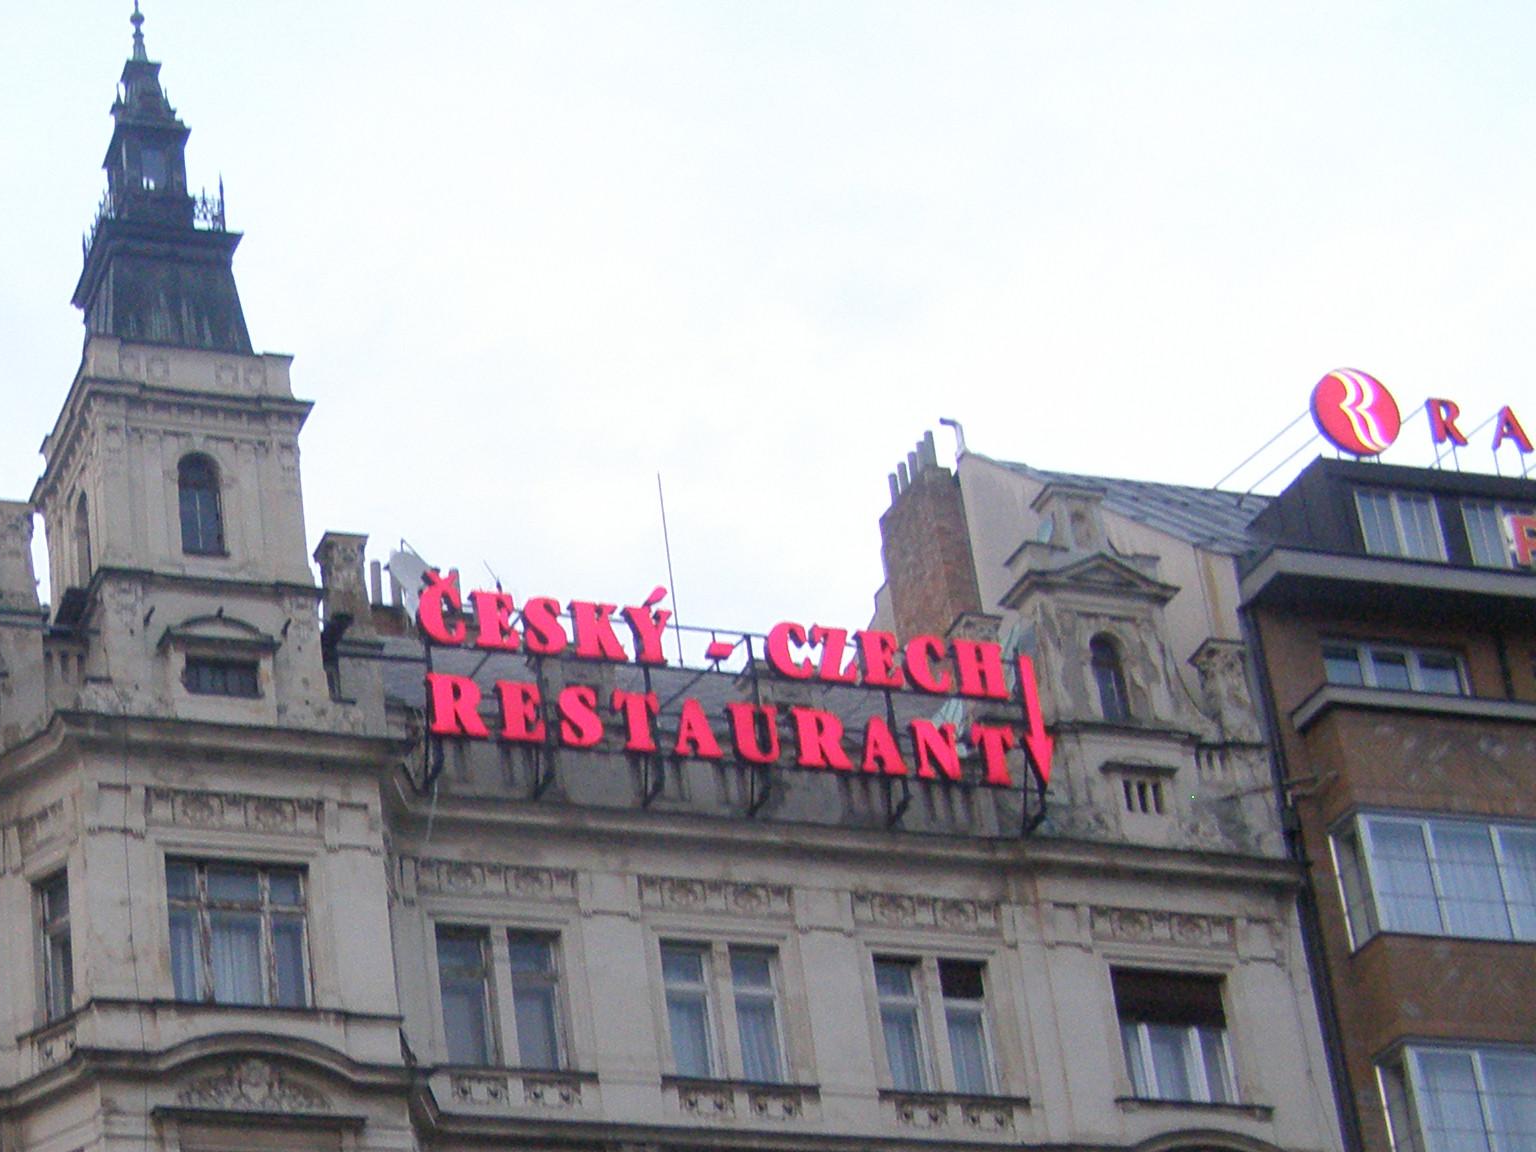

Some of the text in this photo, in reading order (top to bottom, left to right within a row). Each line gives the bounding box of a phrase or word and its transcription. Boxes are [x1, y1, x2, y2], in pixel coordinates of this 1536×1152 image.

[417, 569, 672, 665] ČESKÝ
[765, 621, 1011, 700] CZECH
[426, 671, 1015, 787] RESTAURANT
